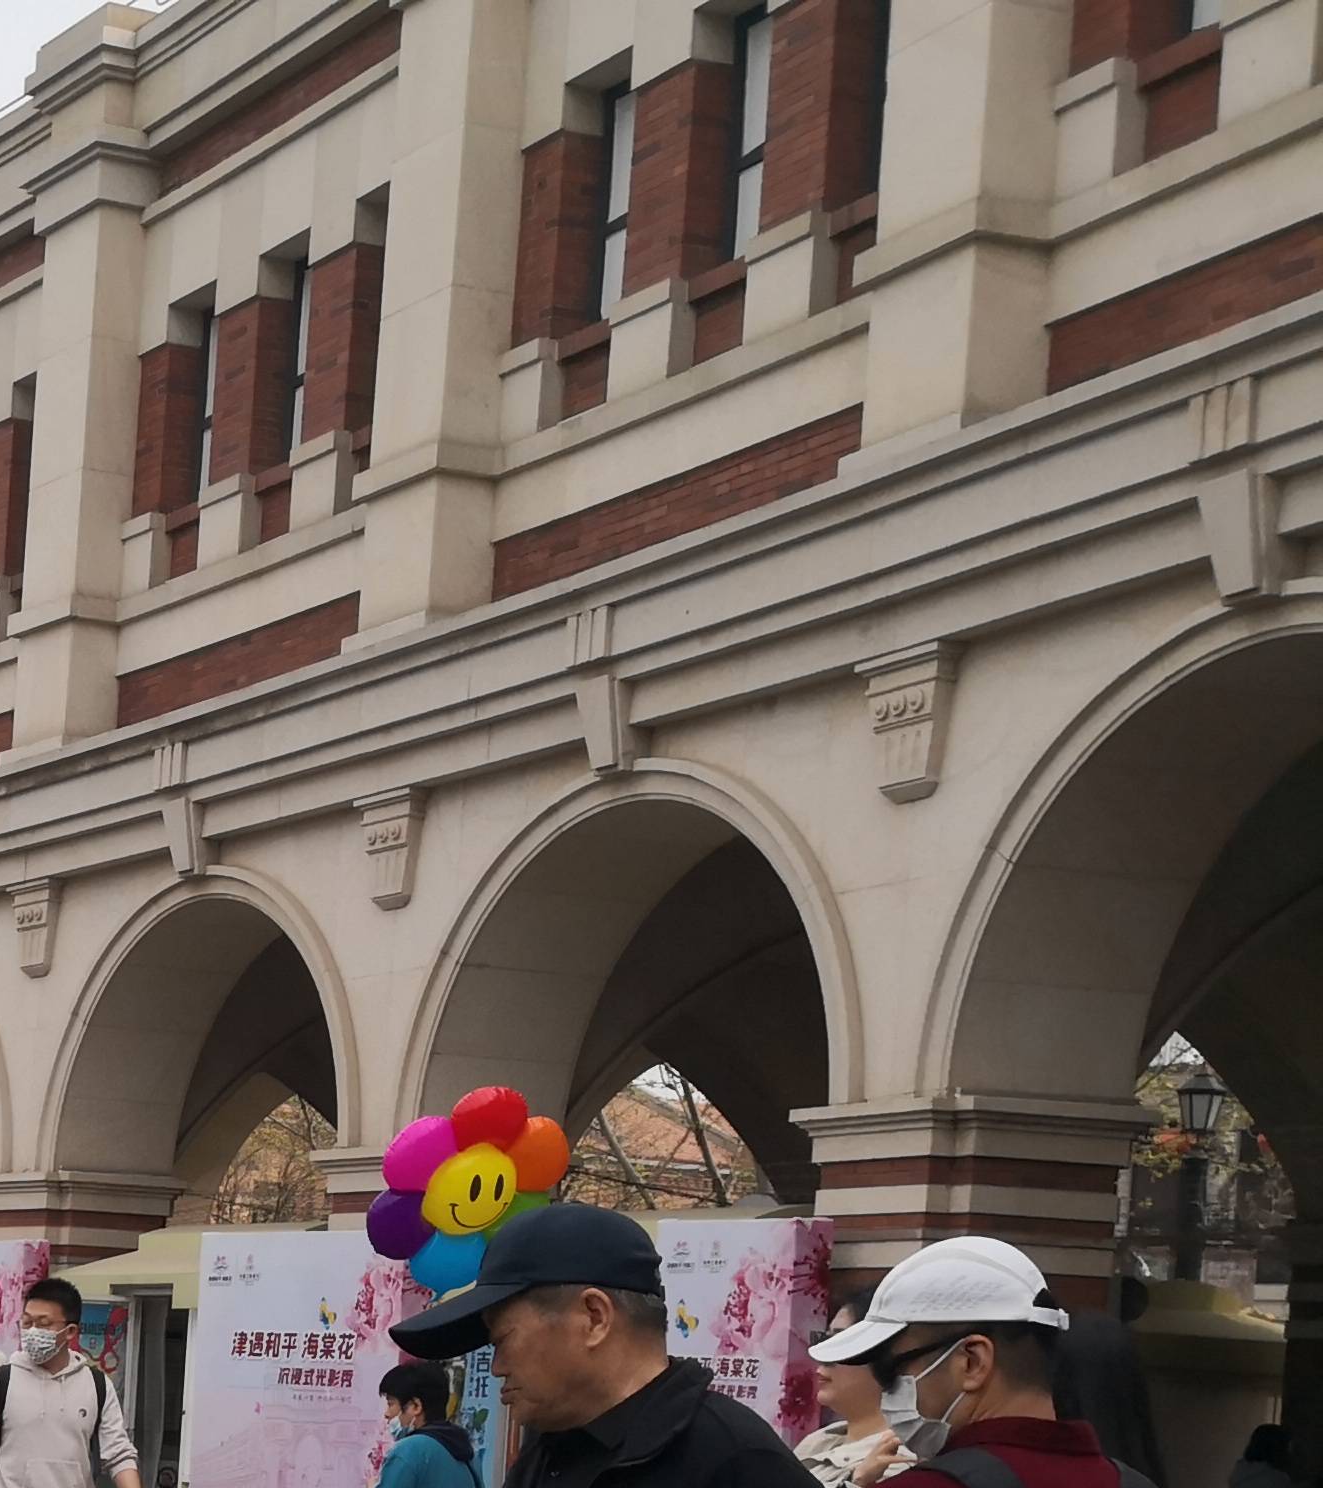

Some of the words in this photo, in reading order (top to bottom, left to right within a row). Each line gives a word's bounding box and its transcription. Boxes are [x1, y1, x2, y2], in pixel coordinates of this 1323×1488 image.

[231, 1331, 297, 1358] 津遇和平
[301, 1332, 355, 1360] 海棠花
[277, 1367, 354, 1388] 沉浸式光影秀
[475, 1345, 492, 1398] 吉托
[714, 1357, 759, 1378] 海棠花
